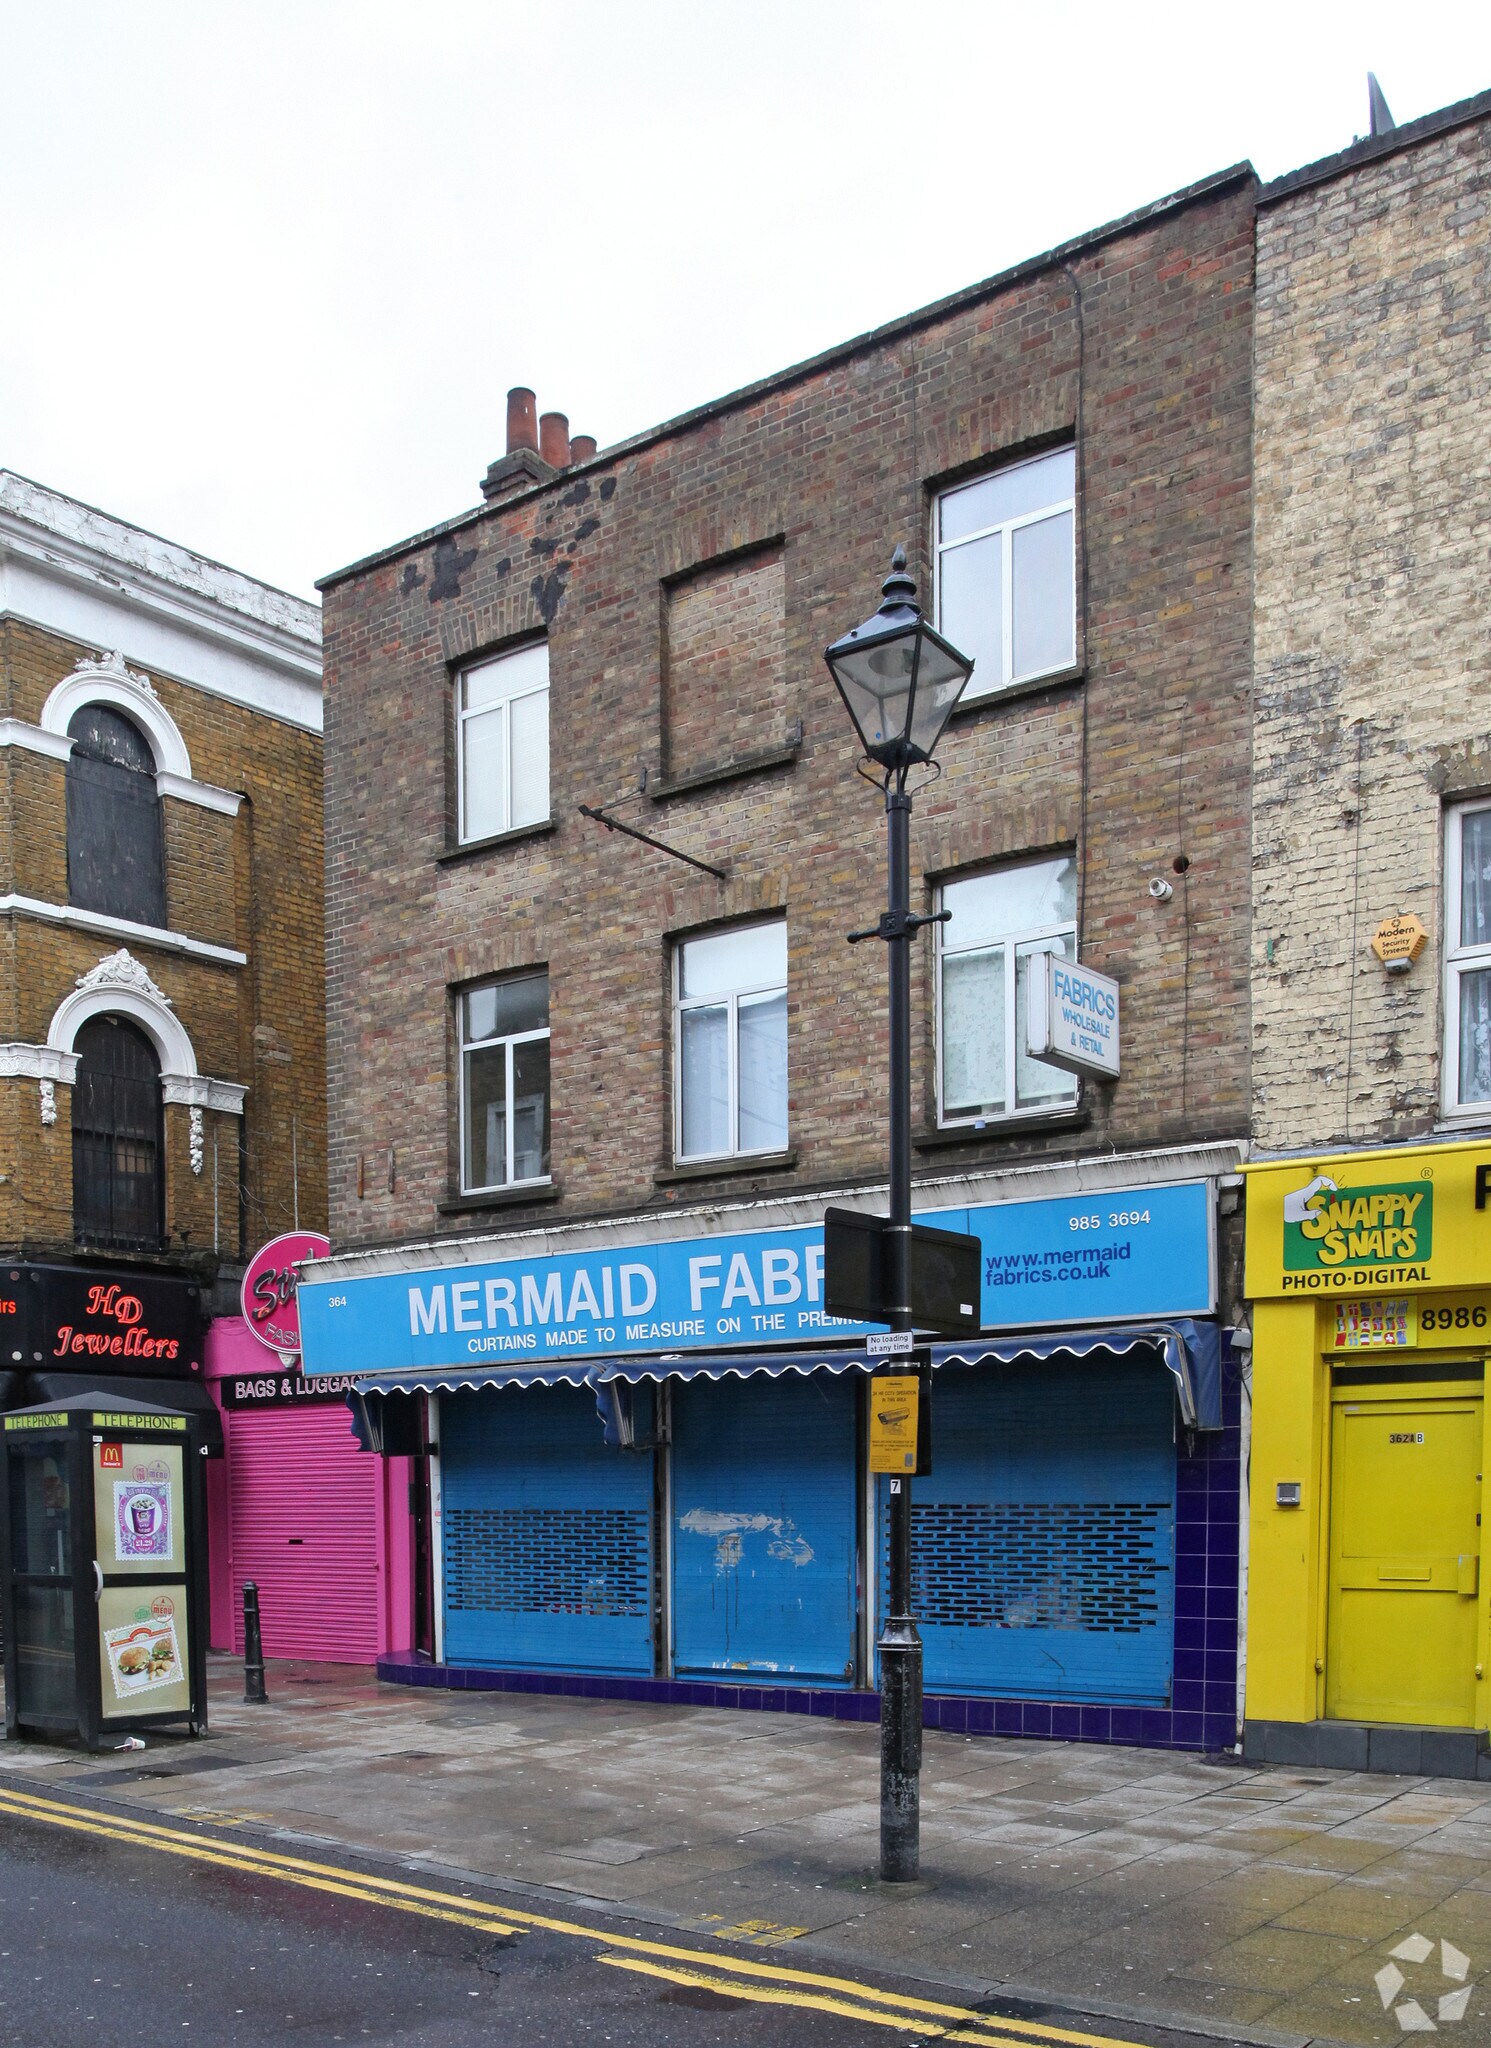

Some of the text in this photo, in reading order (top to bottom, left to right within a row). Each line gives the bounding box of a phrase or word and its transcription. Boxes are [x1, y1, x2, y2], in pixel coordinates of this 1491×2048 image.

[1378, 927, 1415, 938] Modern
[1382, 938, 1410, 948] Security
[1382, 946, 1410, 956] Systems
[1054, 969, 1115, 1020] FABRICS
[1062, 1006, 1110, 1039] WHOLESALE
[1071, 1031, 1104, 1057] & RETAIL
[1069, 1210, 1151, 1231] 985 3694
[1301, 1192, 1424, 1240] SNAPPY
[986, 1241, 1131, 1269] www.mermaid
[1317, 1227, 1417, 1265] SNAPS
[985, 1261, 1111, 1287] fabrics.co.uk
[328, 1296, 347, 1308] 364
[408, 1263, 658, 1336] MERMAID
[1421, 1306, 1487, 1330] 8986
[53, 1326, 180, 1359] Jewellers
[468, 1333, 536, 1353] CURTAINS
[546, 1329, 588, 1347] MADE
[595, 1327, 615, 1342] TO
[626, 1319, 705, 1340] MEASURE
[716, 1317, 741, 1334] ON
[751, 1313, 786, 1331] THE
[870, 1335, 909, 1344] No loading
[894, 1343, 910, 1351] time
[235, 1379, 276, 1399] BAGS
[281, 1378, 293, 1397] &
[10, 1413, 62, 1429] TELEPHONE
[101, 1412, 179, 1430] TELEPHONE
[891, 1480, 899, 1492] 7
[153, 1606, 172, 1615] MENU
